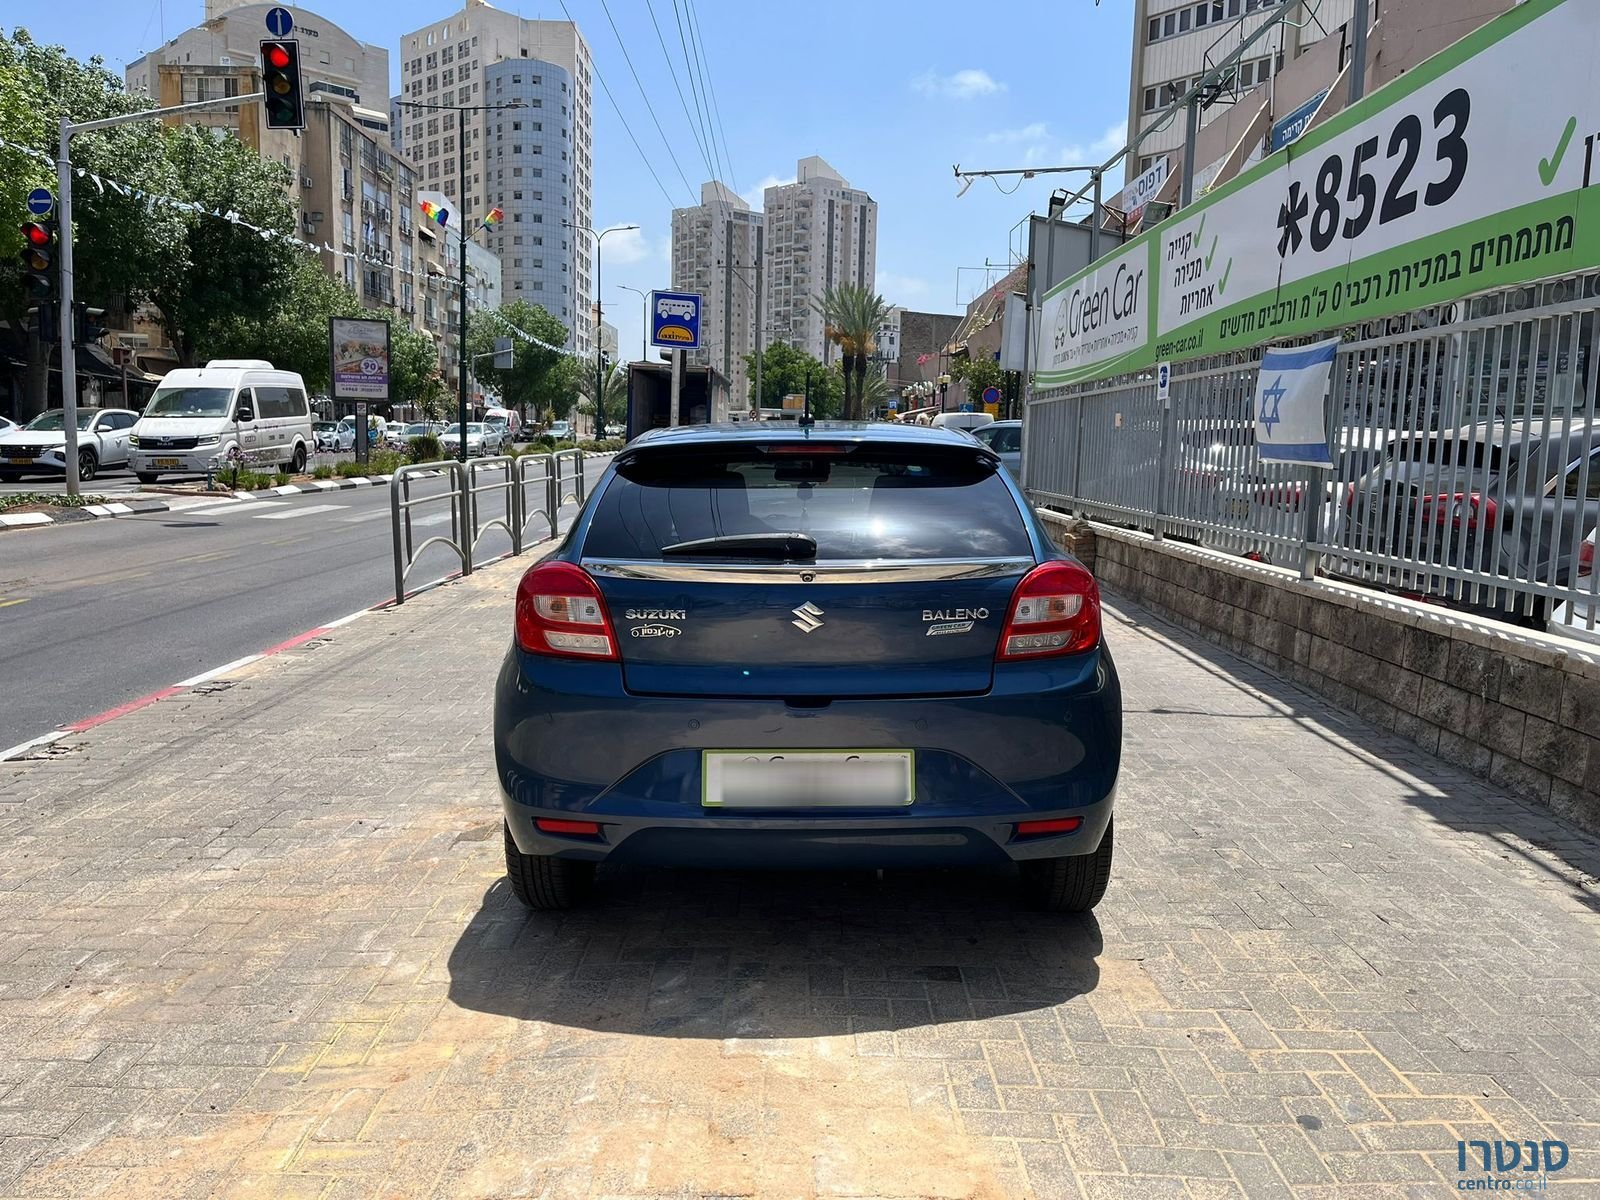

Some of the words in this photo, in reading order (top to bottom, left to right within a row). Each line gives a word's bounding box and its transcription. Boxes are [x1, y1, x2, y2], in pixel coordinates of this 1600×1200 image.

[1138, 166, 1162, 197] דפוס
[1167, 231, 1192, 261] קנייה
[1469, 215, 1574, 274] מתמחים
[1174, 257, 1202, 288] מכירה
[1385, 249, 1462, 297] במכירת
[1069, 286, 1109, 338] Green
[1113, 263, 1143, 321] Car
[1179, 284, 1215, 315] אחריות
[1332, 281, 1342, 311] 0
[1347, 274, 1381, 308] רכבי
[1219, 311, 1255, 339] חדשים
[1257, 298, 1297, 330] ורכבים
[1155, 327, 1204, 362] green-car.co.il
[363, 362, 376, 371] 90
[625, 608, 686, 620] SUZUKI
[922, 607, 990, 621] BALENO
